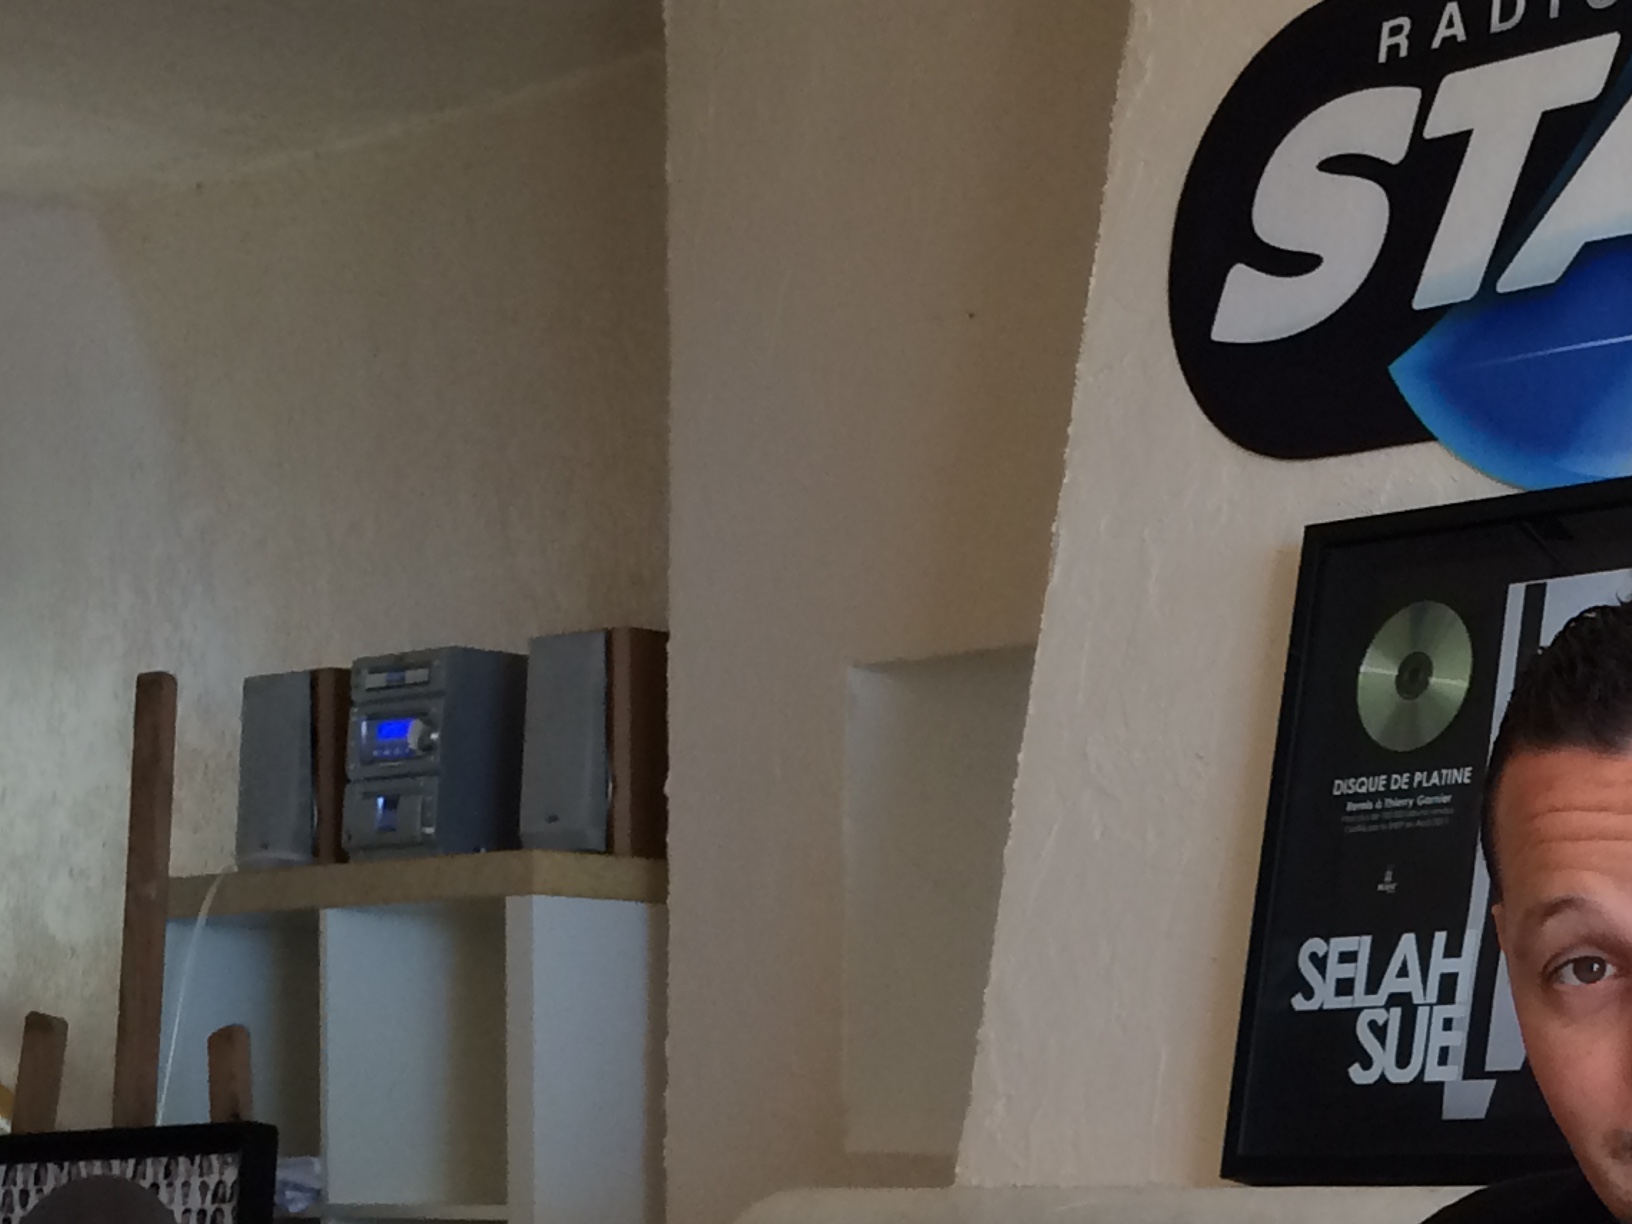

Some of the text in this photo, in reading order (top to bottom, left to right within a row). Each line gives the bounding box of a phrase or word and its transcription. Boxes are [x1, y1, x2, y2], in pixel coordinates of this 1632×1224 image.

[1377, 0, 1618, 64] RAD
[1331, 765, 1474, 797] DISQUE DE PLATINE
[1290, 929, 1479, 1011] SELAH
[1347, 1004, 1470, 1085] SUE
